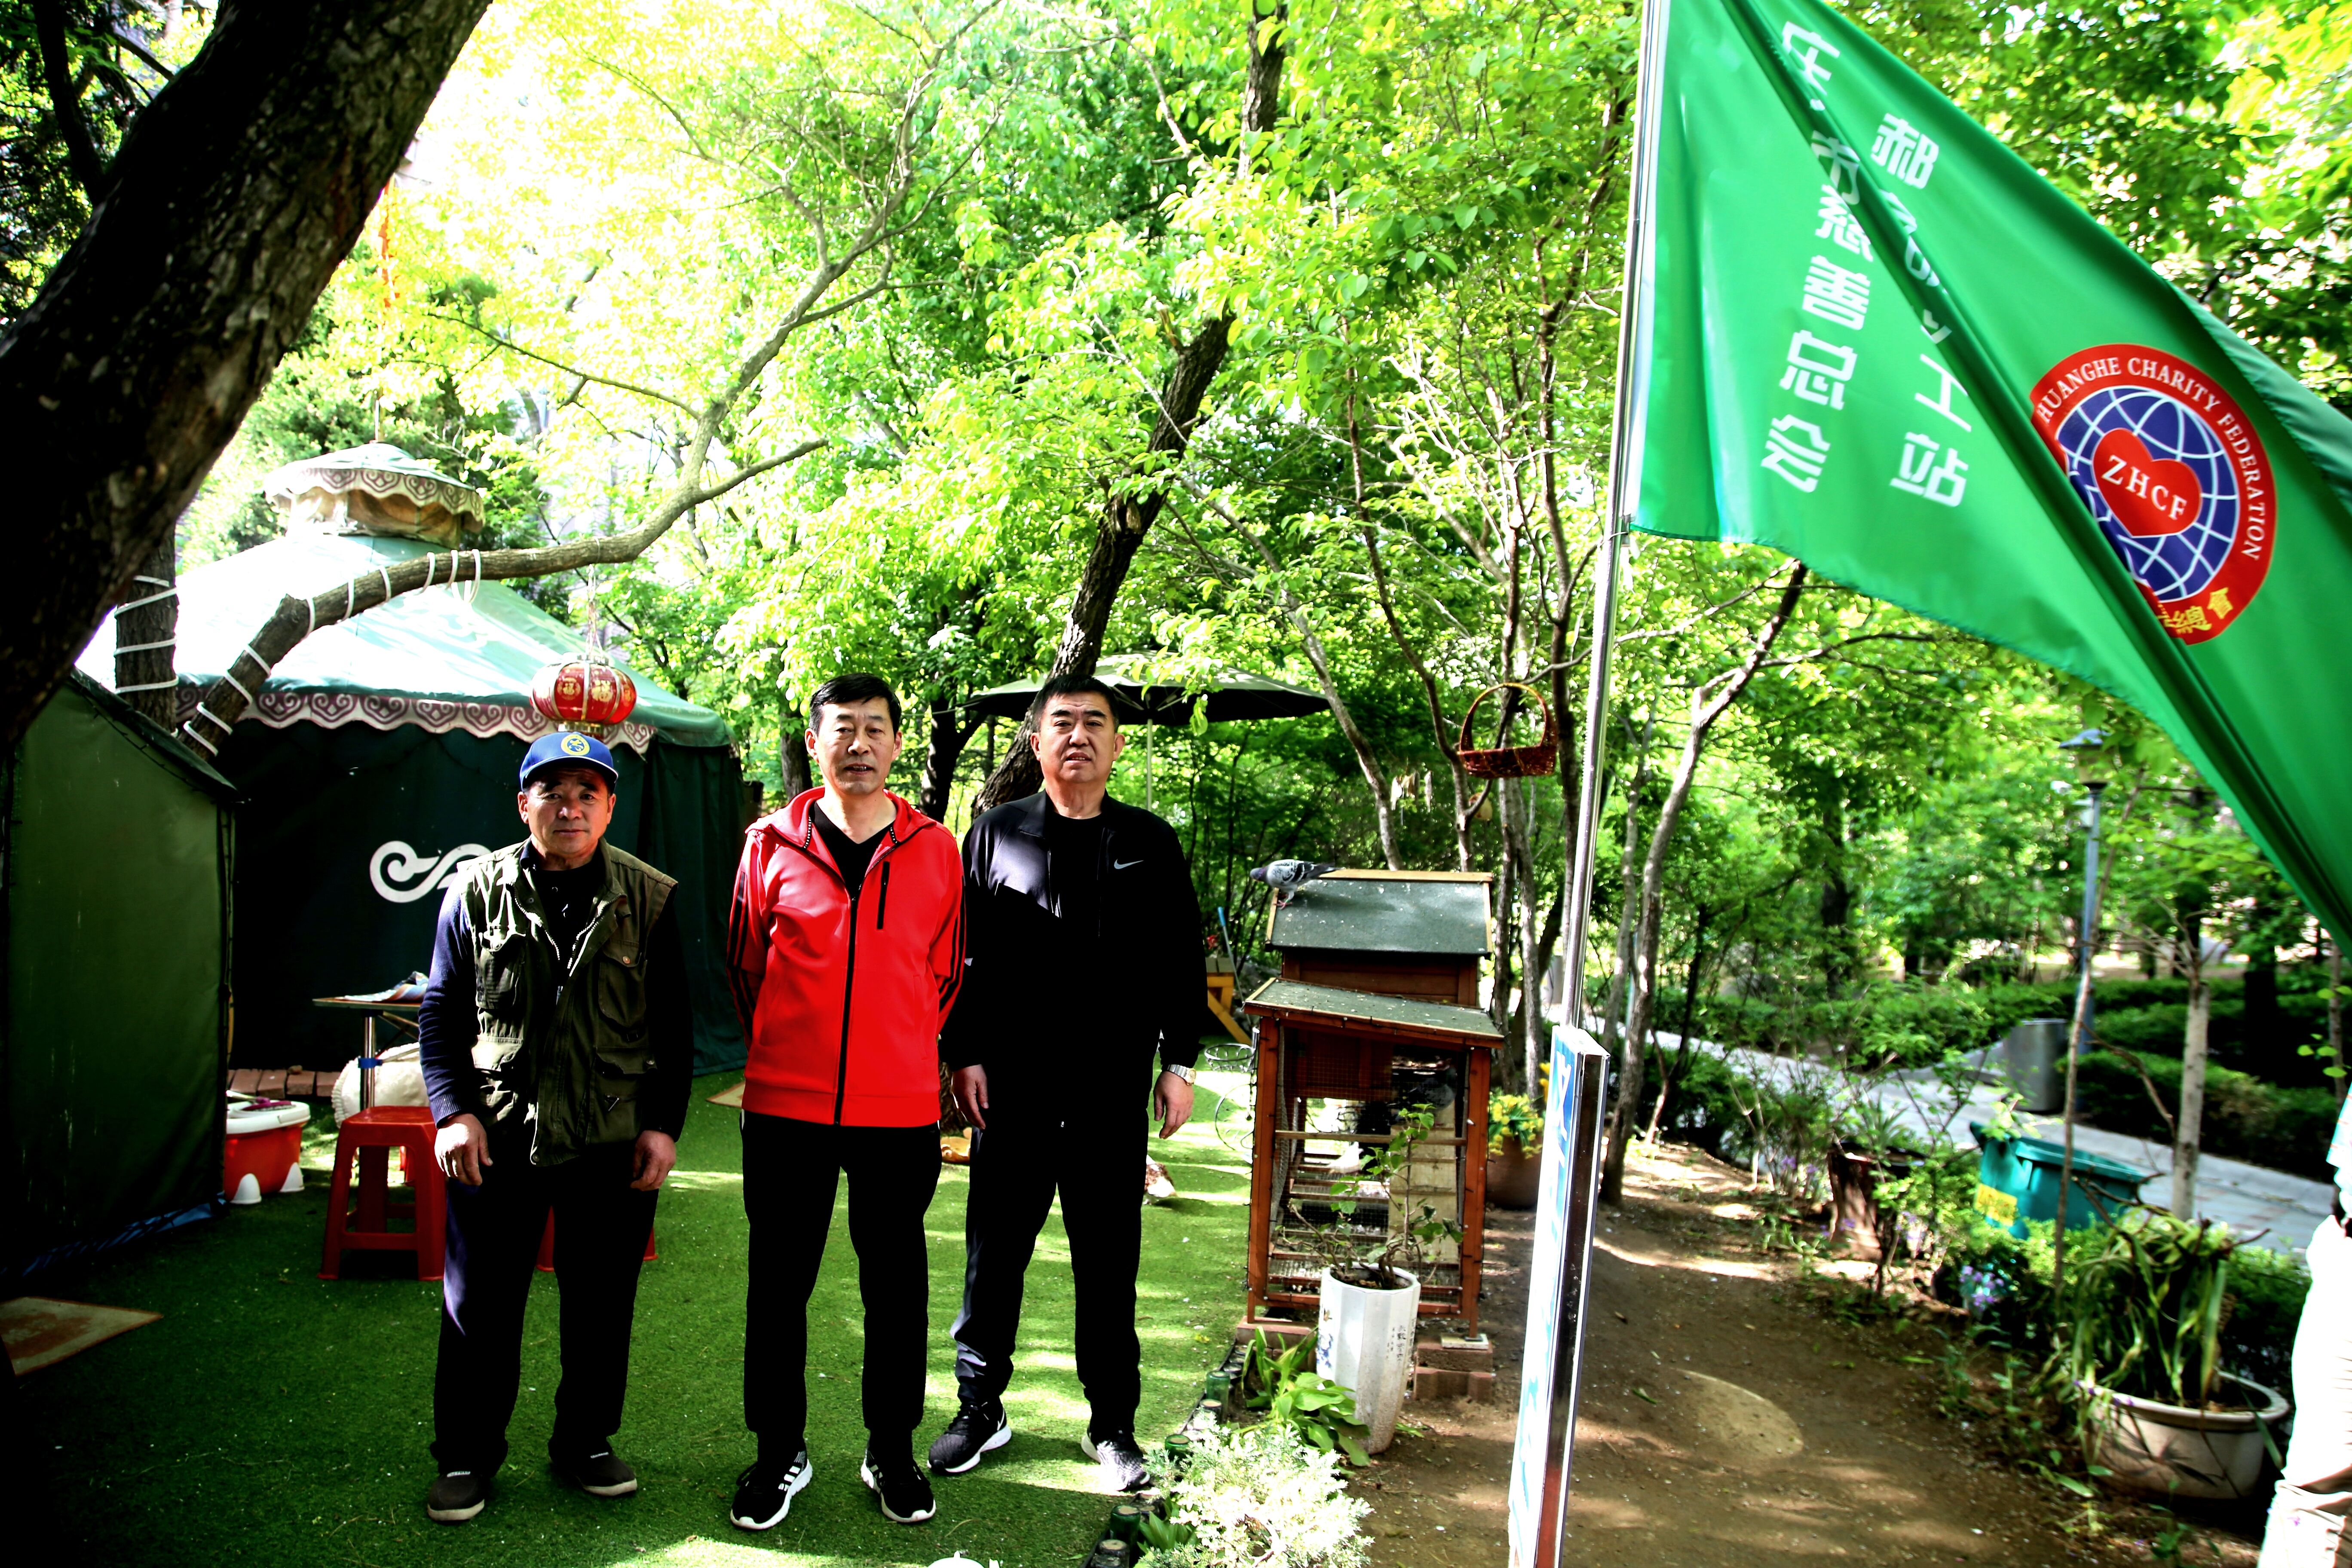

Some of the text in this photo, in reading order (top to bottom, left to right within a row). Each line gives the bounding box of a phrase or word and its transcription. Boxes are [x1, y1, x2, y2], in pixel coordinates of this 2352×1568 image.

[1761, 21, 1874, 493] 庄市慈善总会
[2102, 454, 2187, 521] ZHCF
[2127, 357, 2221, 412] CHARITY
[2217, 413, 2265, 560] FEDERATION
